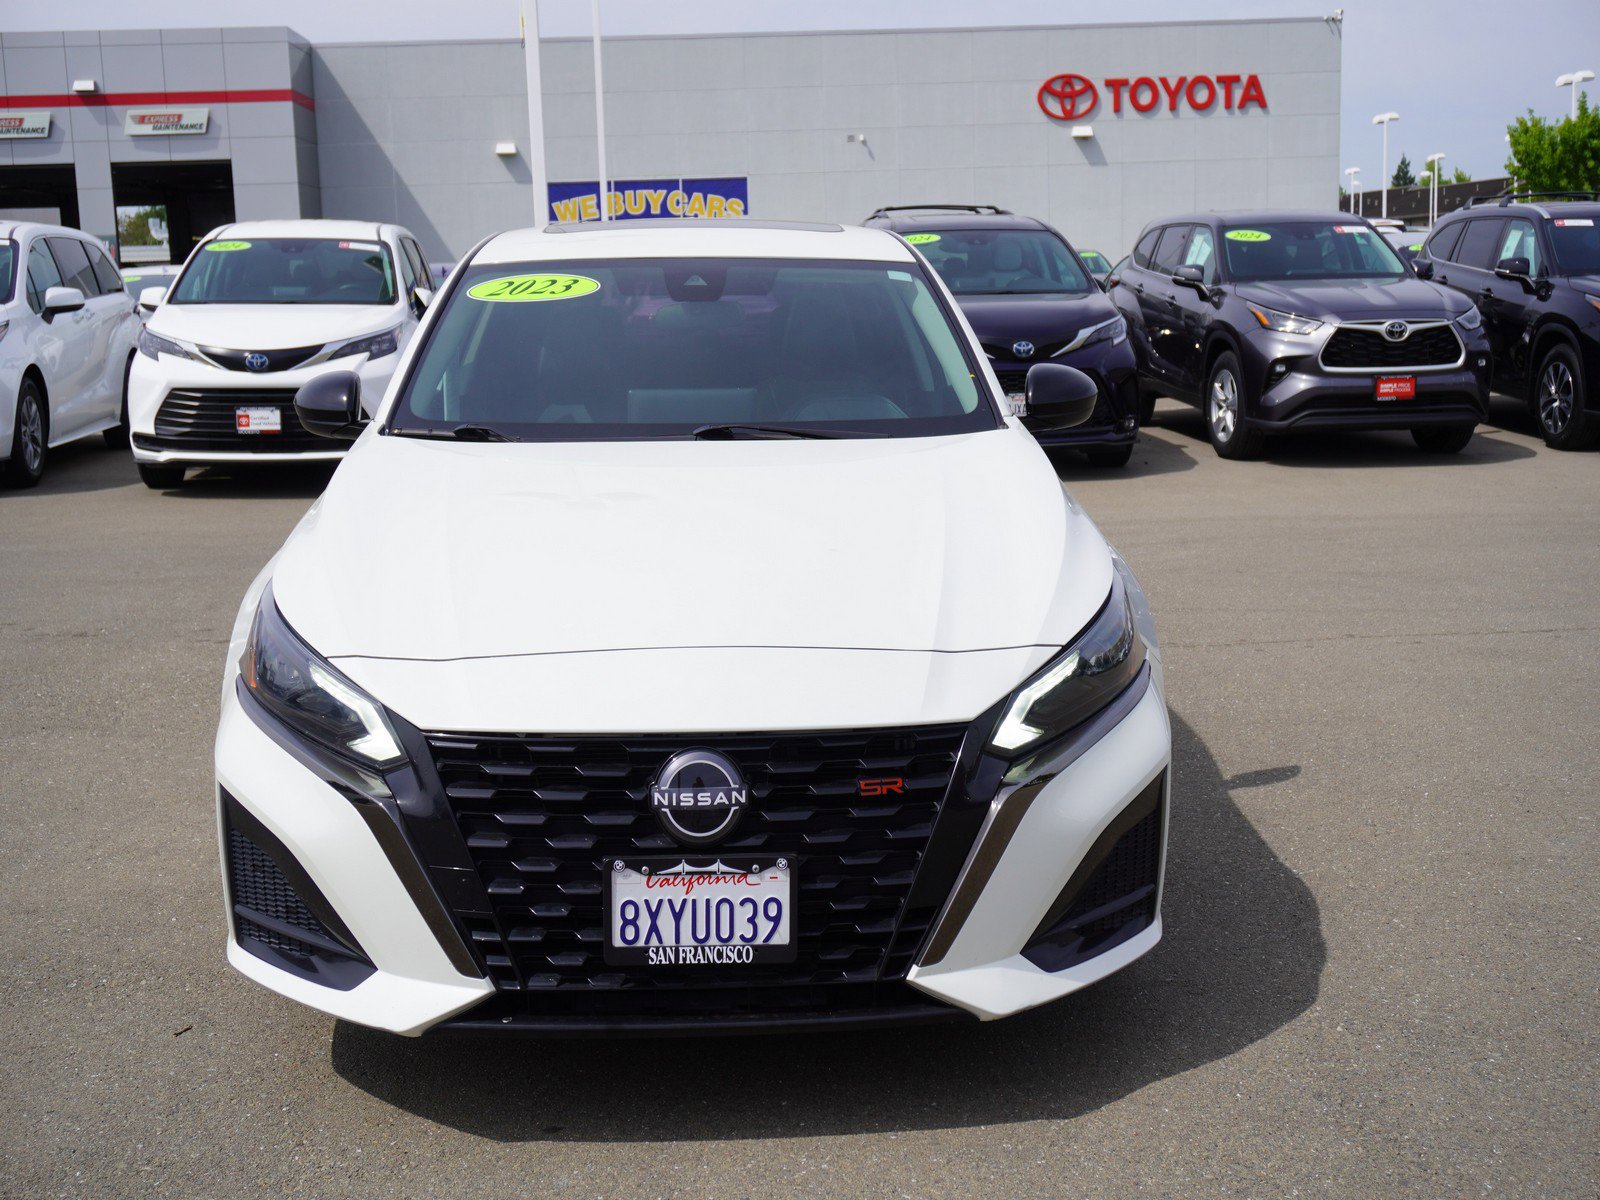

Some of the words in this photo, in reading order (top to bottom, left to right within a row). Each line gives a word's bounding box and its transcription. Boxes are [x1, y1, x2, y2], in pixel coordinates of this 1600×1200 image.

[1104, 75, 1267, 113] TOYOTA
[152, 123, 204, 131] MAINTENANCE
[552, 194, 599, 223] WE
[607, 190, 667, 216] BUY
[667, 190, 745, 218] CARS
[485, 279, 580, 297] 2023
[860, 777, 903, 797] SR
[654, 790, 746, 807] NISSAN
[646, 873, 761, 895] California
[619, 896, 783, 946] 8XYU039
[648, 946, 676, 965] SAN
[678, 945, 754, 964] FRANCISCO
